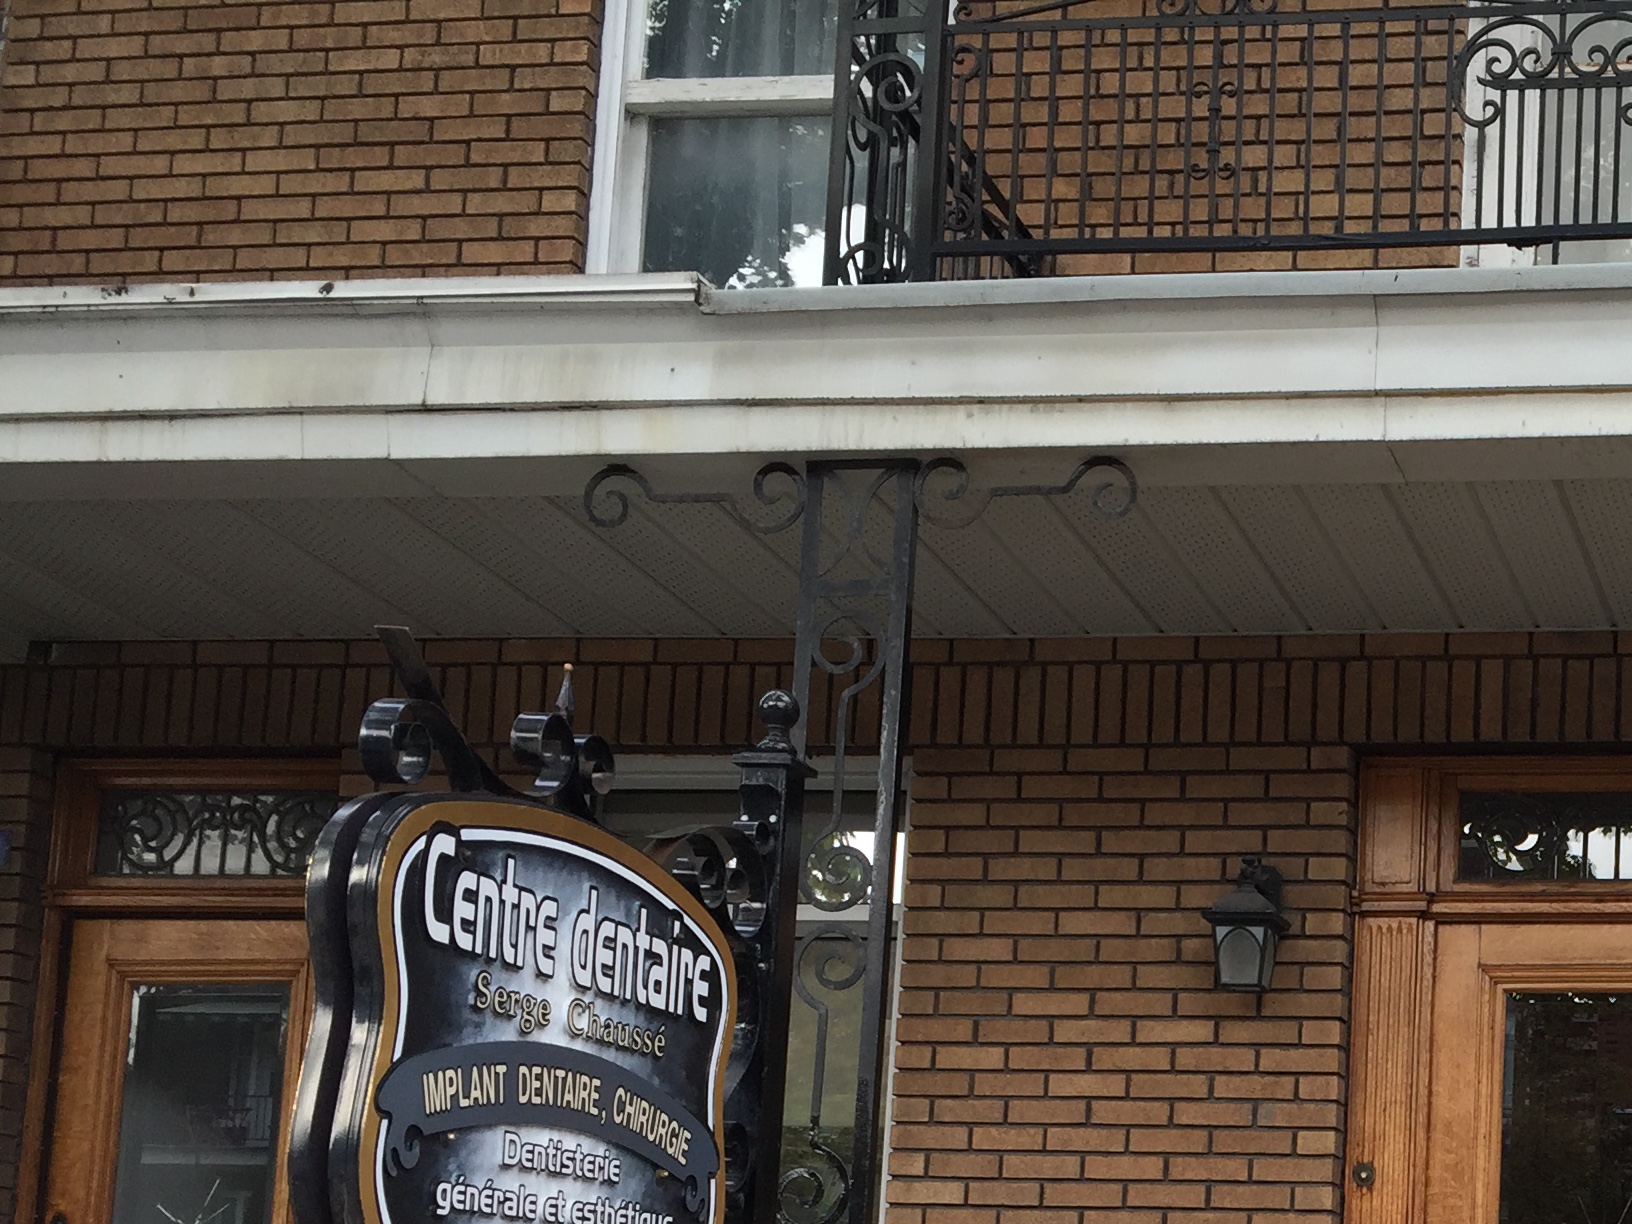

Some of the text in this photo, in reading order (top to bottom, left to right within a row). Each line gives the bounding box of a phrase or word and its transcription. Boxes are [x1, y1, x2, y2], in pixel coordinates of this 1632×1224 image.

[424, 832, 711, 1023] Centre dentaire
[476, 971, 666, 1057] Serge Chaussé
[422, 1064, 692, 1166] IMPLANT DENTAIRE, CHIRURGIE
[503, 1130, 621, 1183] Dentisterie
[436, 1176, 537, 1218] générale
[543, 1190, 566, 1223] et
